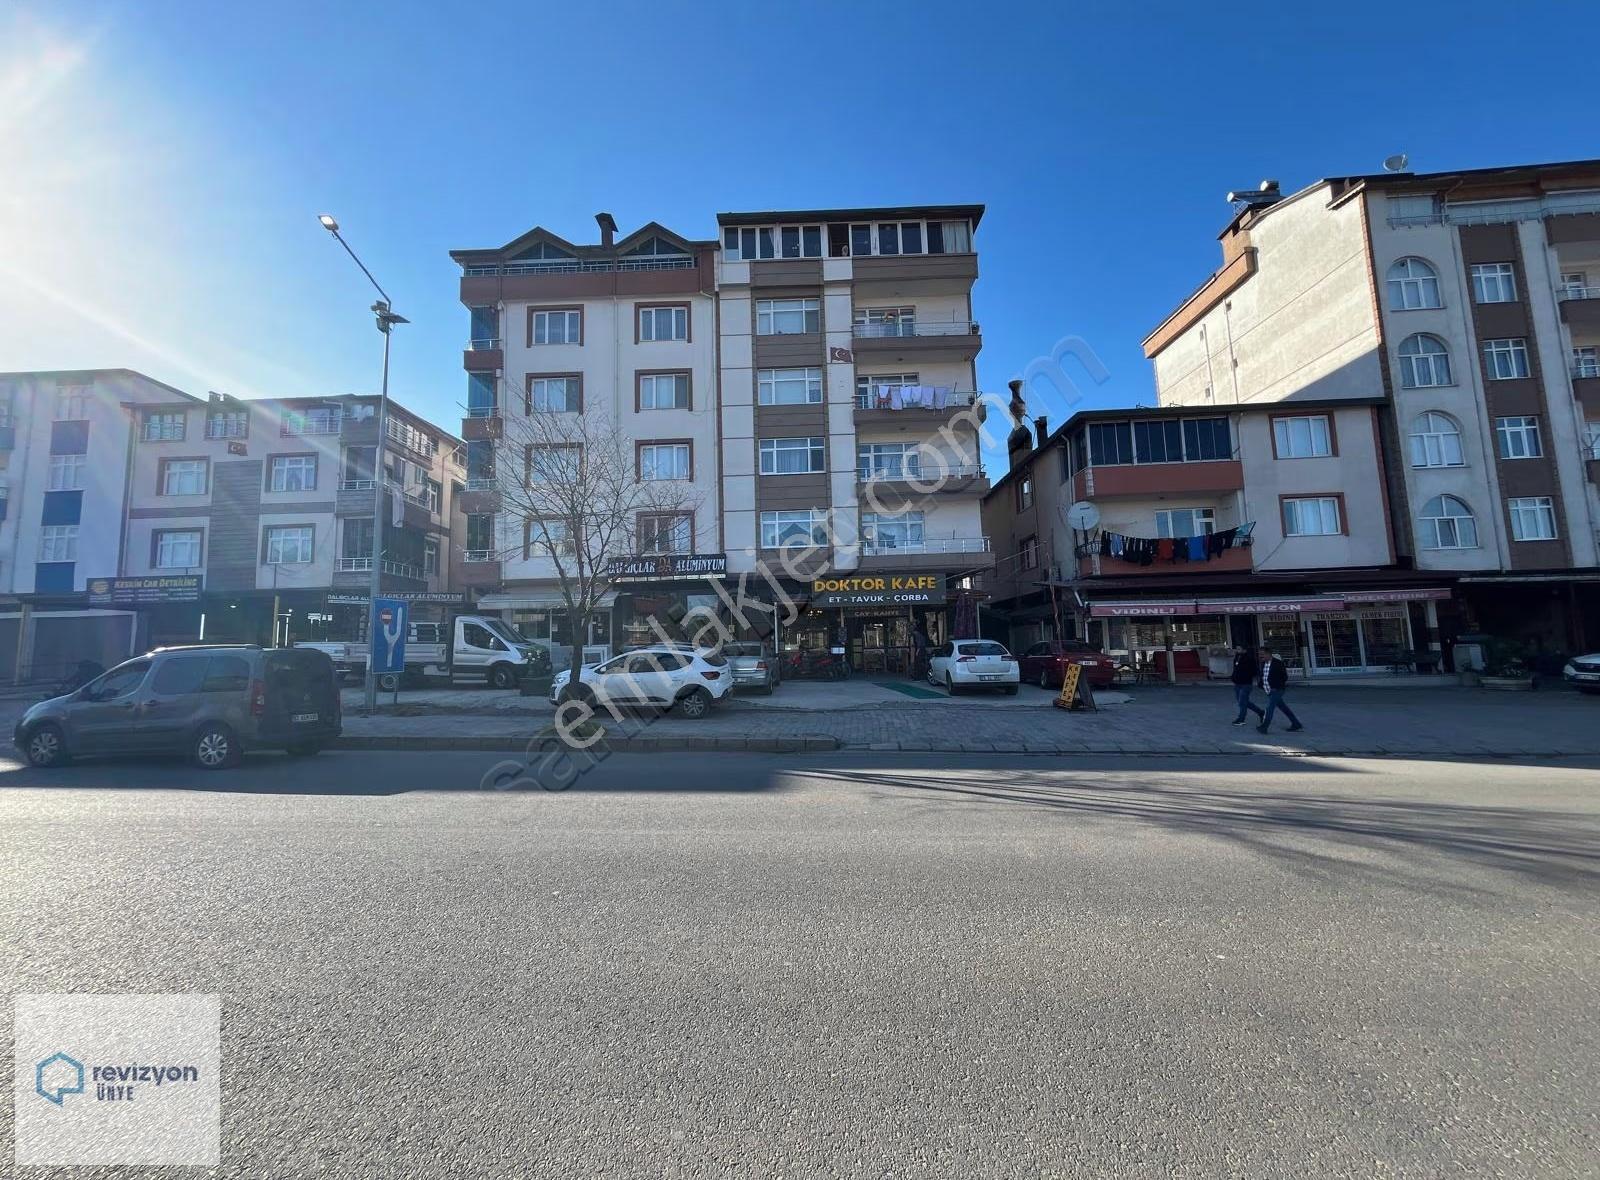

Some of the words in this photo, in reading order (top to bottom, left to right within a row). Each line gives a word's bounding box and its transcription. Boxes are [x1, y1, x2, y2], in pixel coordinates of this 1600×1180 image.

[813, 578, 886, 593] DOKTOR
[891, 575, 937, 590] KAFE
[828, 595, 842, 604] ET
[851, 594, 885, 604] TAVUK
[893, 593, 930, 603] ÇORBA
[1224, 603, 1301, 613] TRABZON
